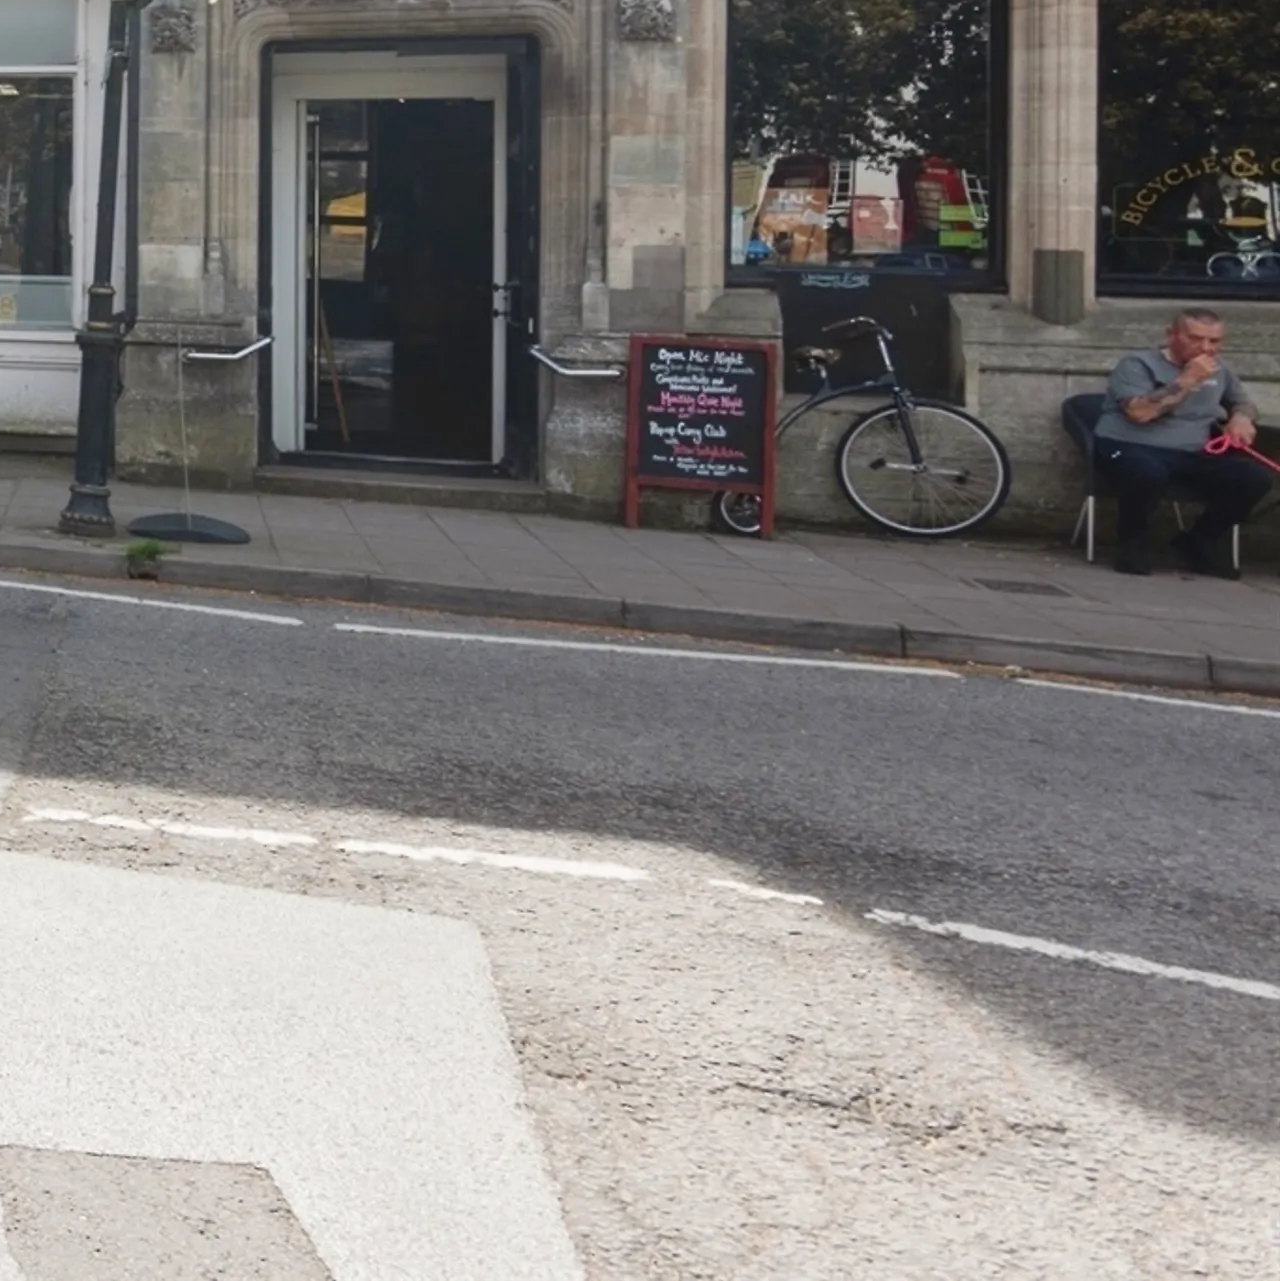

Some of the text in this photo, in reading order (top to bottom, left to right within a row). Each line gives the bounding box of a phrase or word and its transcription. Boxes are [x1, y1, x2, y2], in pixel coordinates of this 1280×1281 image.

[1121, 148, 1264, 226] BICYCLE &
[657, 348, 744, 373] Open Mic Night
